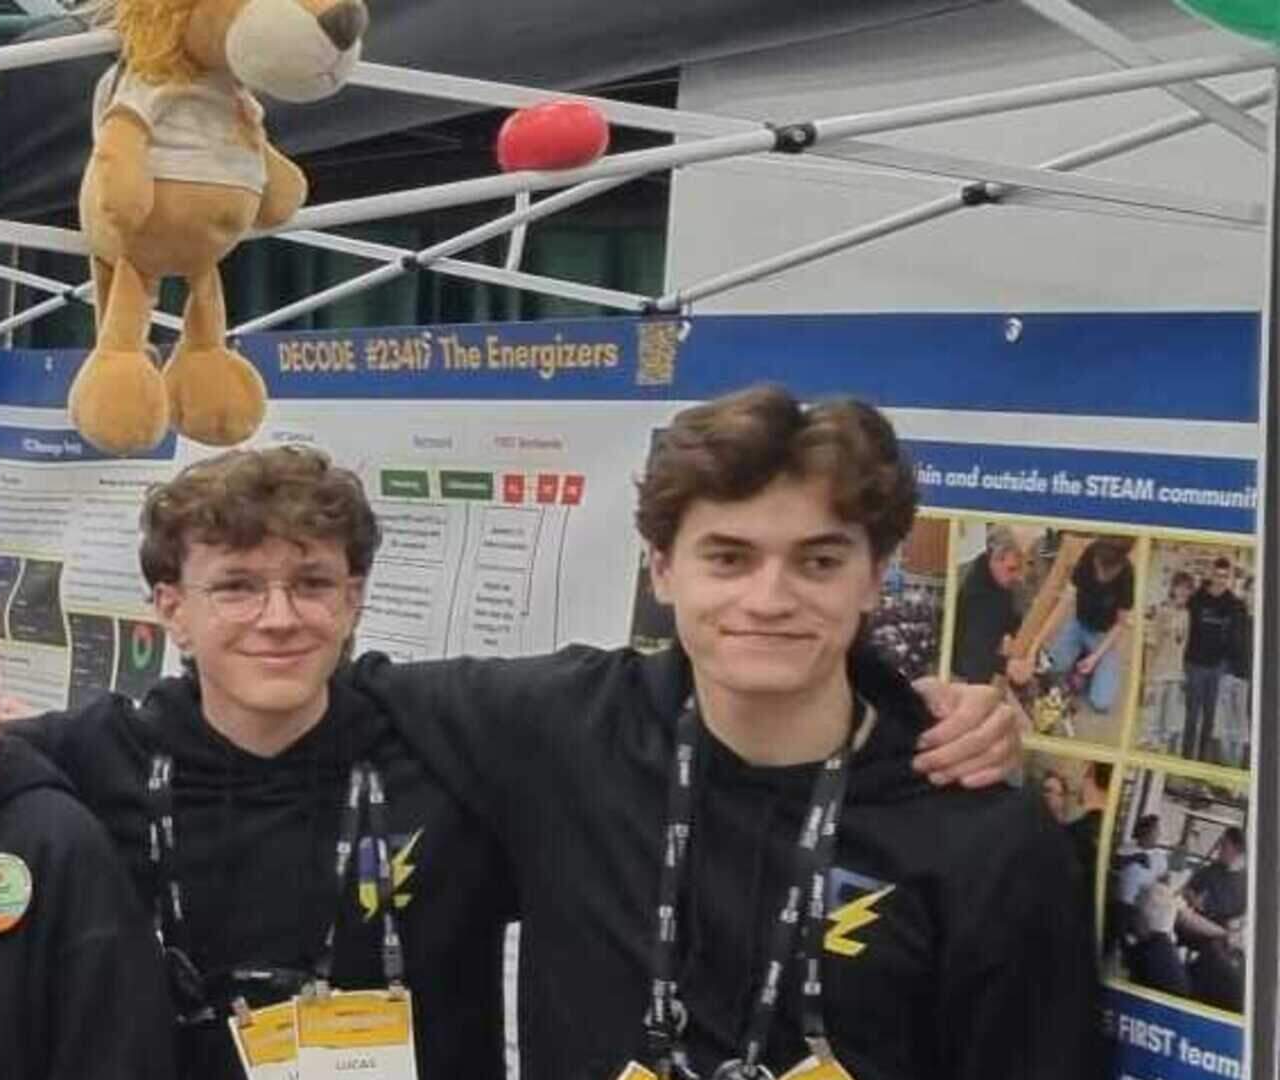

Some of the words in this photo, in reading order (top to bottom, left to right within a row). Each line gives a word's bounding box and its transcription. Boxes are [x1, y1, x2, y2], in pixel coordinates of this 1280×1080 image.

[278, 340, 356, 372] DECODE
[439, 335, 481, 369] The
[487, 335, 619, 379] Energizers
[945, 464, 980, 488] and
[982, 468, 1048, 495] outside
[1052, 472, 1082, 497] the
[1086, 473, 1154, 501] STEAM
[1158, 484, 1258, 509] communit
[1118, 1012, 1177, 1057] FIRST
[1178, 1036, 1248, 1080] team
